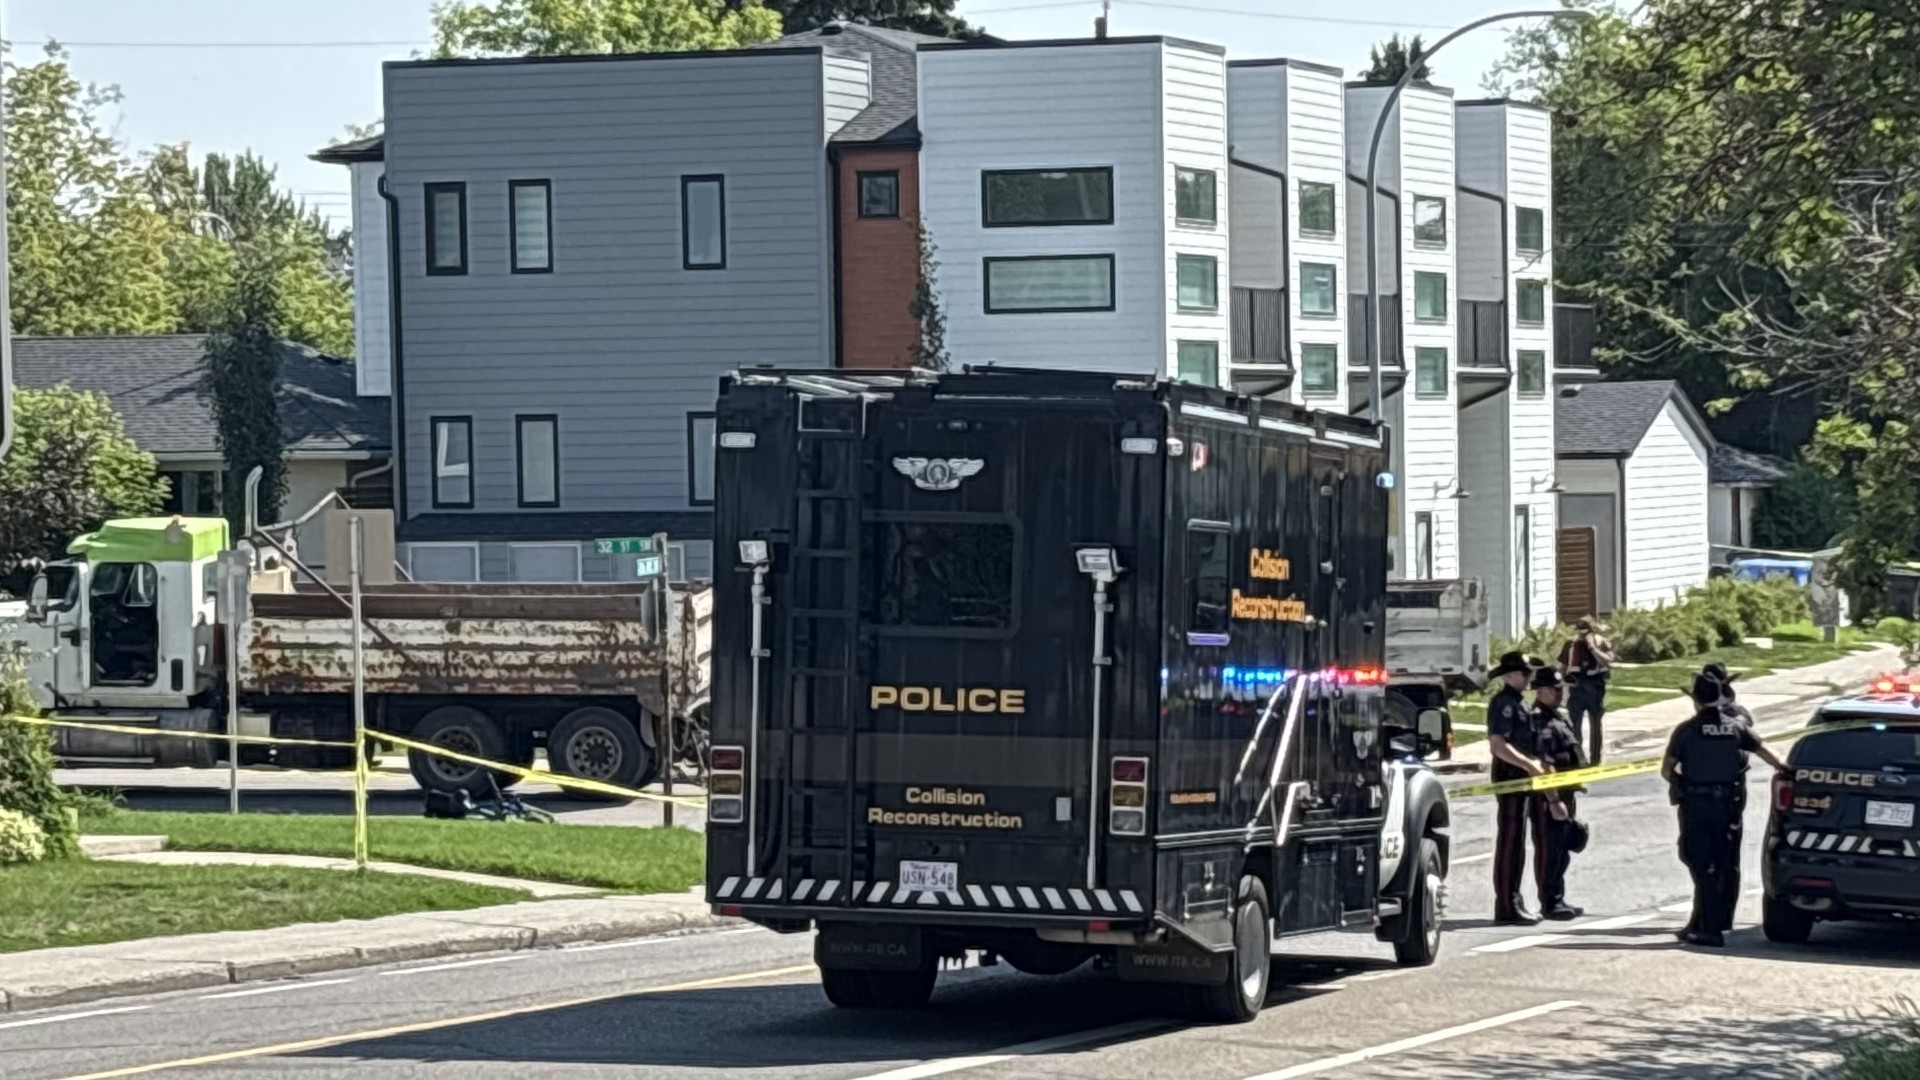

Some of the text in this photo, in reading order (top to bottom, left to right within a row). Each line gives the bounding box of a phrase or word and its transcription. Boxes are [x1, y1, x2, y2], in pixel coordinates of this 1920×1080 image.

[597, 541, 613, 553] 32
[620, 540, 630, 552] ST
[1250, 548, 1290, 580] Collision
[1231, 588, 1306, 623] Reconstruction
[870, 685, 1026, 714] POLICE
[1702, 723, 1735, 736] POLICE
[1794, 769, 1876, 787] POLICE
[906, 787, 986, 806] Collision
[868, 807, 1023, 829] Reconstruction
